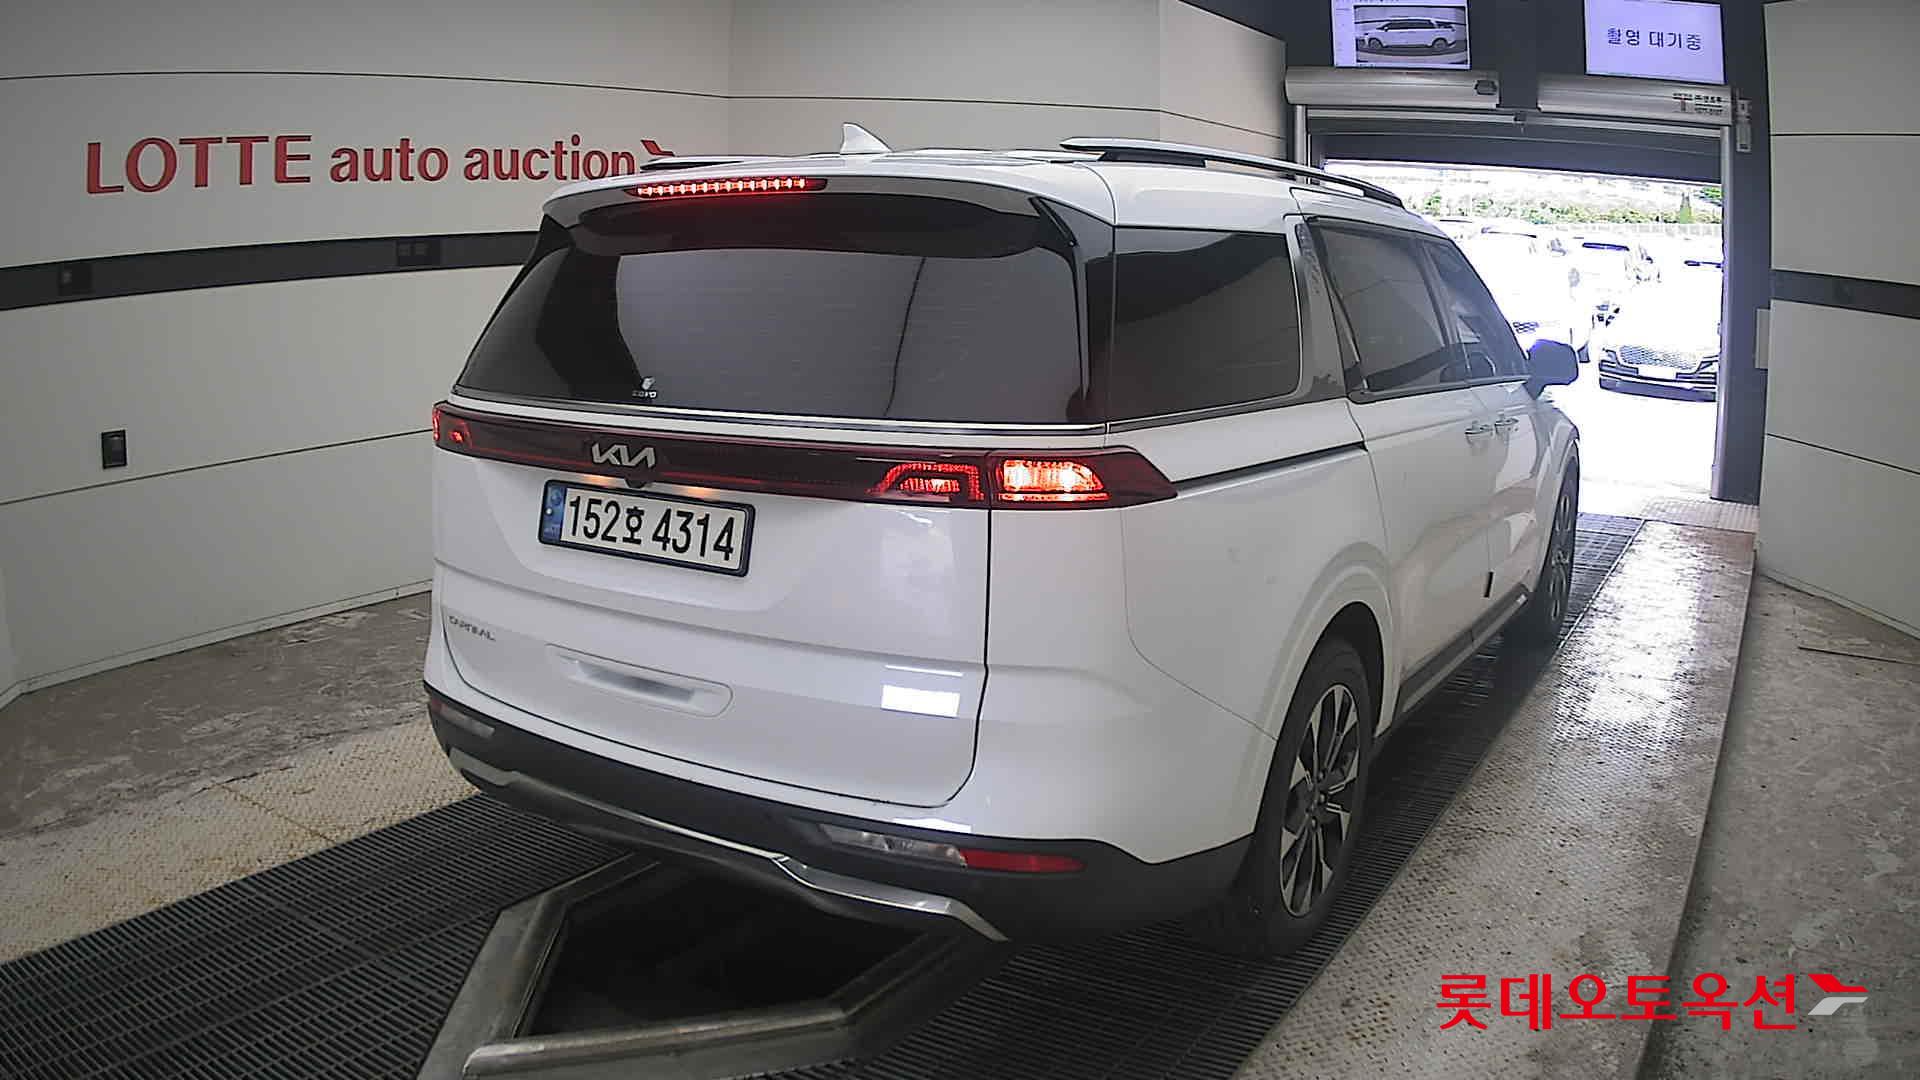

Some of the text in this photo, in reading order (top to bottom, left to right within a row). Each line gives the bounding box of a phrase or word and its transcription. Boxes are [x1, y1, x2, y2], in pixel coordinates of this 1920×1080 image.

[87, 134, 637, 195] LOTTE auto auction
[590, 443, 657, 469] KIA
[568, 495, 736, 562] 152호 4314
